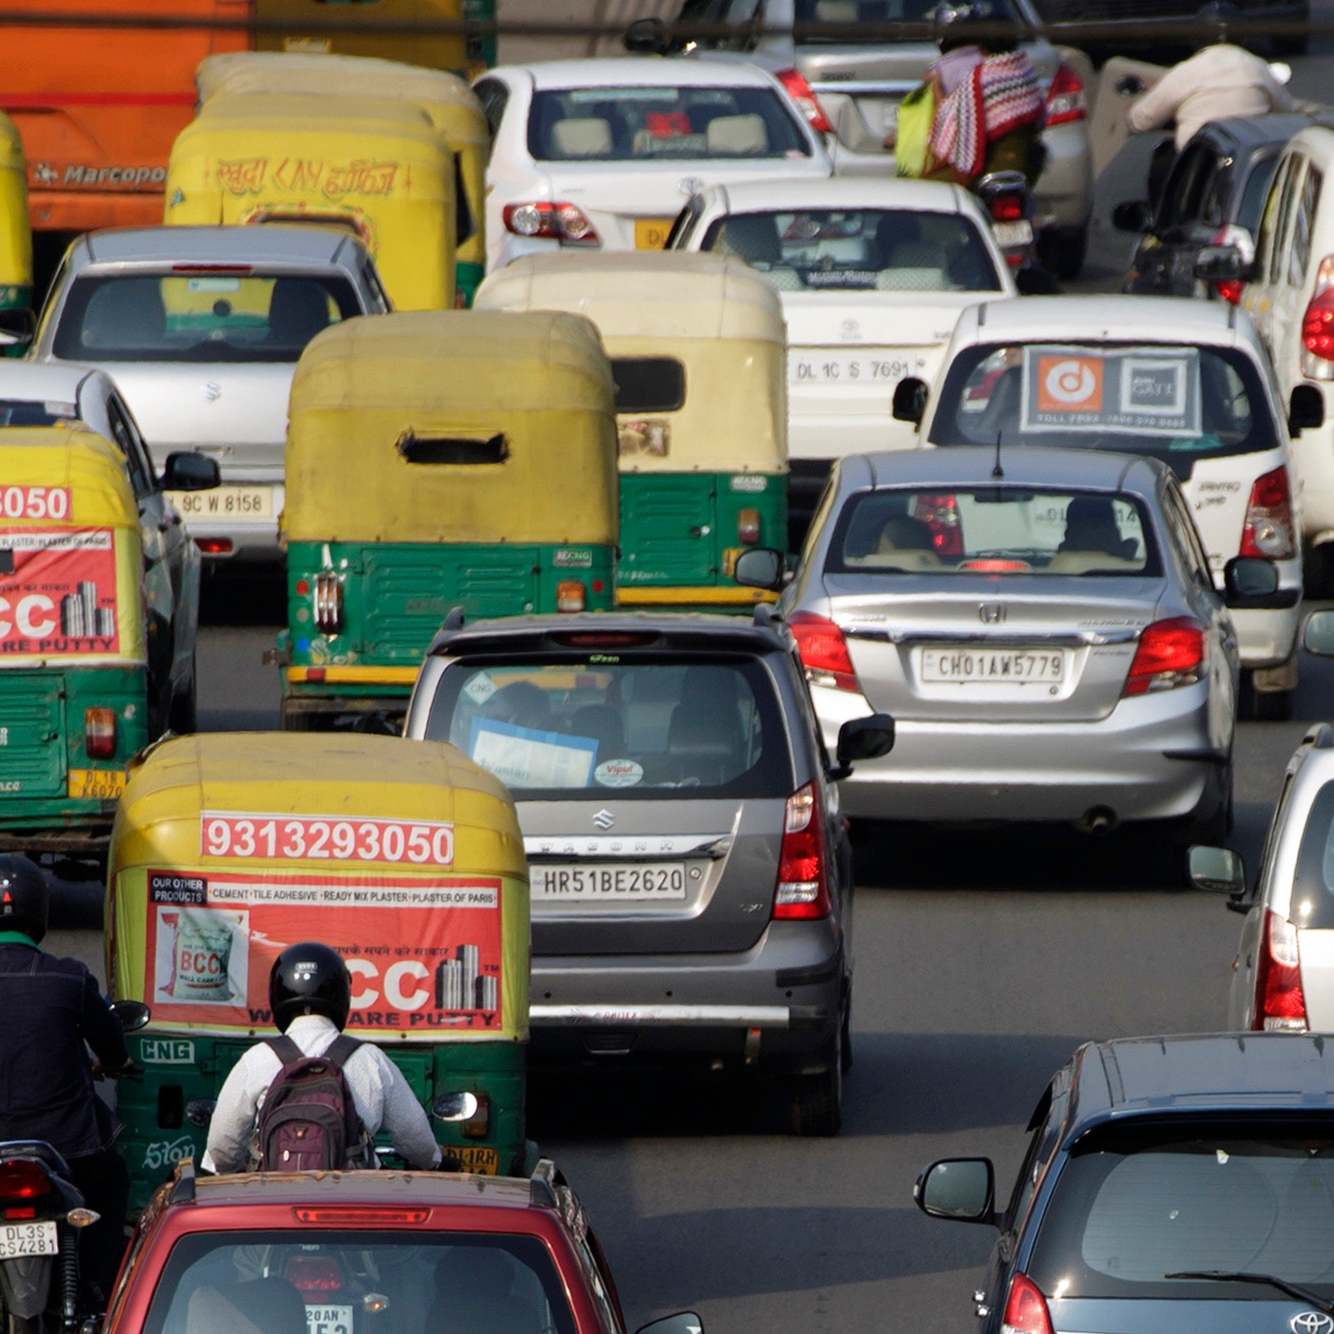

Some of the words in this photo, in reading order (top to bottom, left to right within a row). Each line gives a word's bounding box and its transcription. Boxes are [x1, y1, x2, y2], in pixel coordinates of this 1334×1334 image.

[65, 165, 167, 186] Marcopo
[798, 362, 815, 377] DL
[849, 362, 860, 377] S
[183, 494, 202, 512] 9C
[208, 495, 219, 511] W
[38, 638, 116, 652] PUTTY
[939, 655, 1062, 676] CH01AW5779
[470, 684, 492, 693] CNG
[606, 764, 634, 776] Vipul
[208, 819, 454, 865] 9313293050
[152, 878, 171, 888] OUR
[173, 879, 204, 890] OTHER
[544, 869, 683, 893] HR51BE2620
[155, 890, 203, 902] PRODUCTS
[212, 888, 249, 899] CEMENT
[254, 890, 272, 900] TILE
[273, 890, 318, 901] ADHESIVE
[323, 891, 352, 901] READY
[354, 892, 368, 901] MIX
[370, 892, 409, 902] PLASTER
[412, 893, 452, 903] PLASTER
[454, 893, 466, 903] OF
[468, 894, 495, 904] PARIS
[181, 951, 220, 974] BCC
[345, 958, 430, 1011] CC
[349, 1012, 400, 1026] ARE
[410, 1013, 496, 1026] PUTTY
[144, 1040, 193, 1062] CNG
[142, 1135, 195, 1169] Stop
[6, 1225, 45, 1241] DL3S
